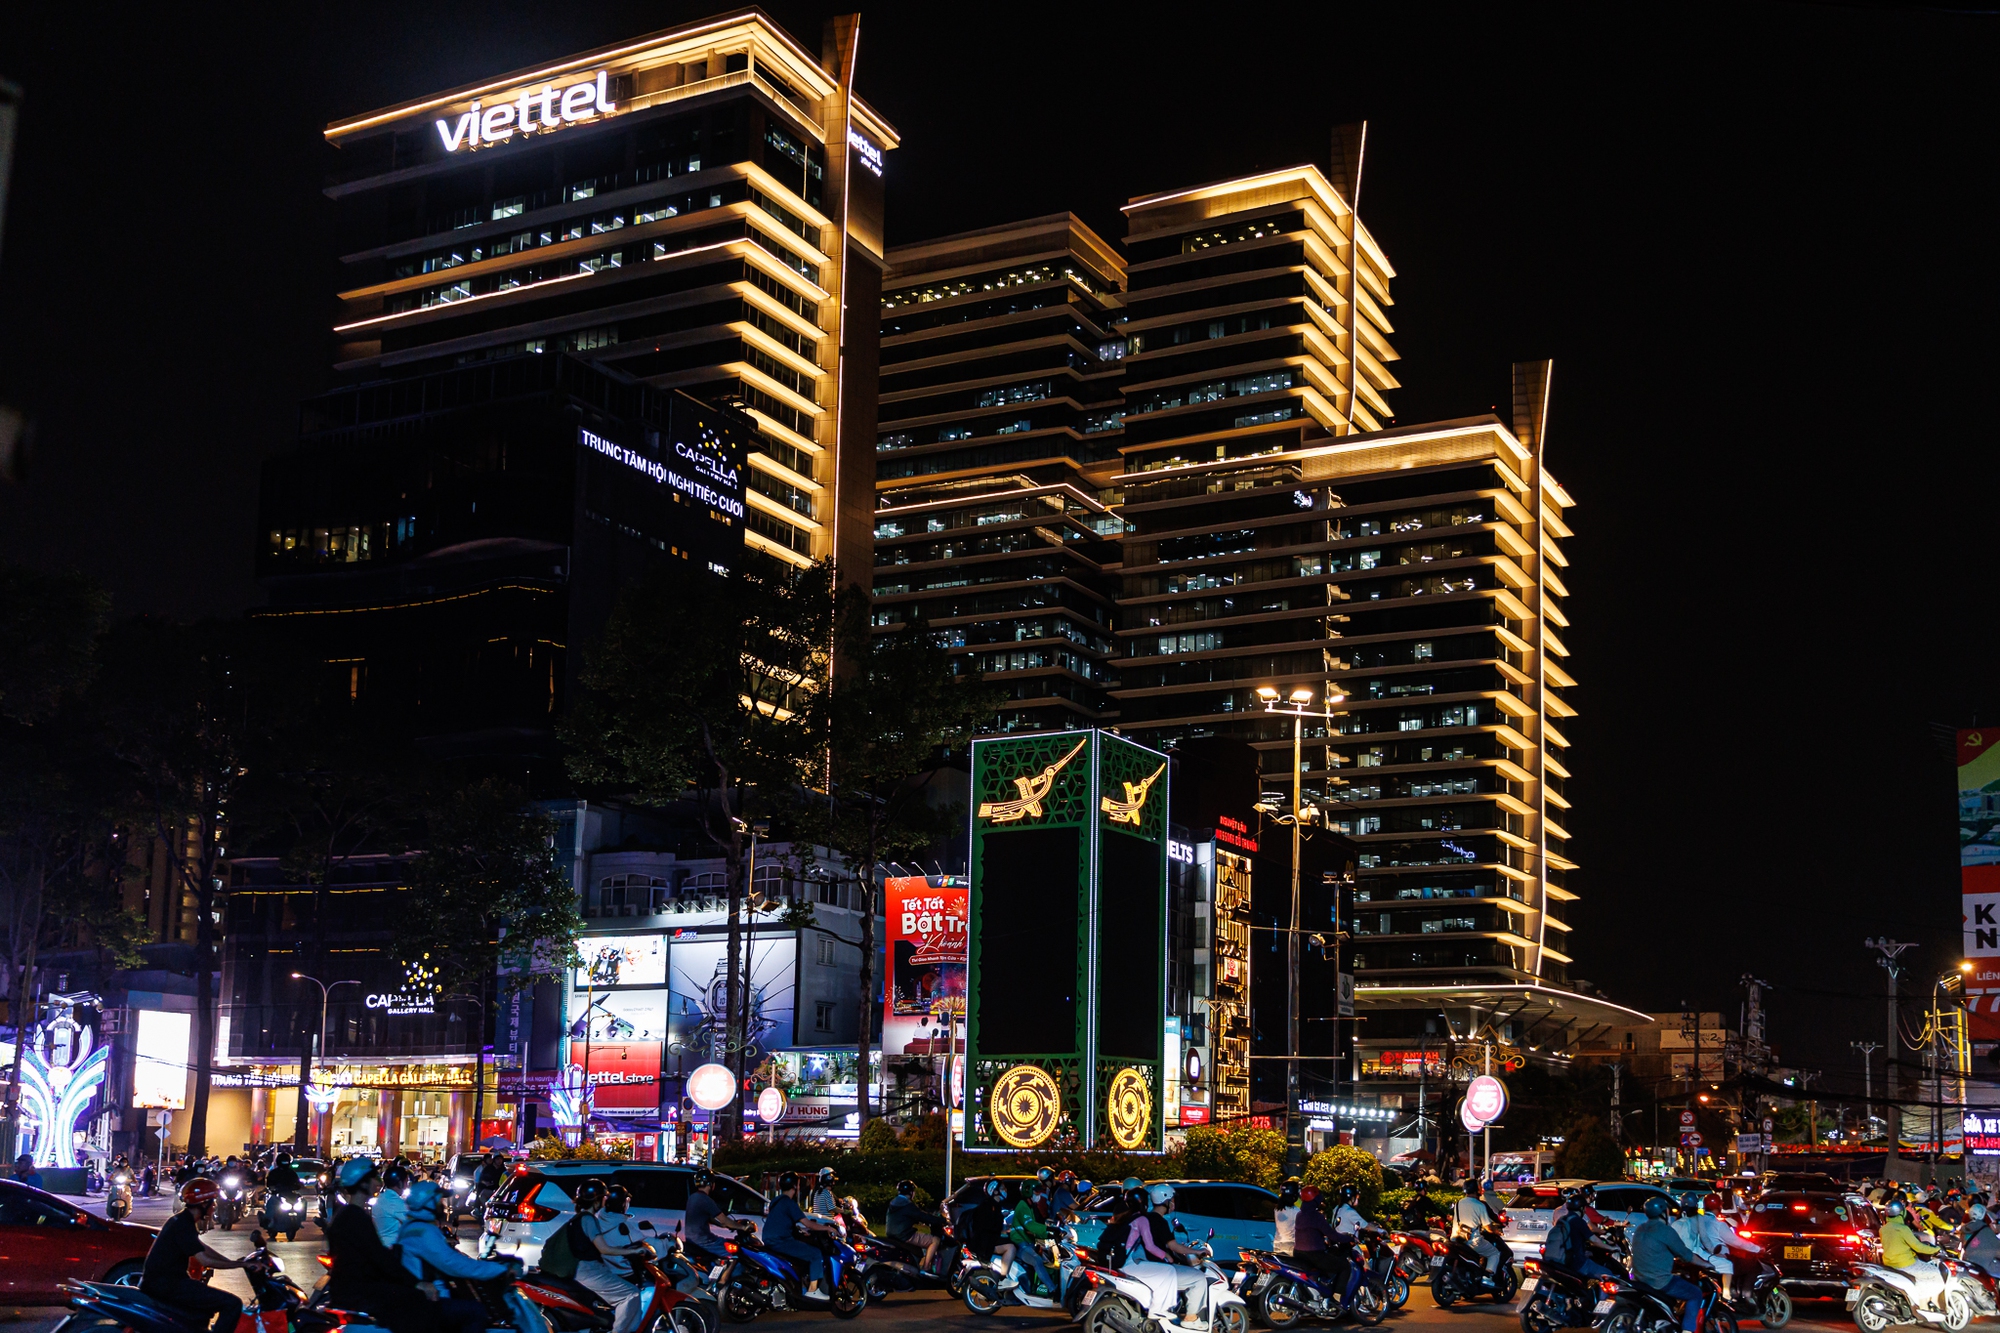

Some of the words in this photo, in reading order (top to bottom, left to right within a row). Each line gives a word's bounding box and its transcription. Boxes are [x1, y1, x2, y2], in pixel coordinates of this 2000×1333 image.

[436, 71, 615, 151] viettel
[582, 430, 622, 461] TRUNG
[623, 449, 646, 472] TÂM
[648, 462, 667, 483] HỘI
[668, 471, 694, 497] NGHỊ
[695, 484, 717, 504] TIỆC
[676, 443, 738, 483] CAPELLA
[901, 896, 922, 911] Tết
[923, 896, 945, 910] Tất
[901, 911, 943, 940] Bật
[945, 915, 969, 933] Tr
[211, 1074, 243, 1086] TRUNG
[354, 1074, 399, 1085] CAPELLA
[798, 1105, 828, 1115] HÙNG
[1252, 1116, 1271, 1128] 275
[1984, 1118, 1997, 1133] XE
[341, 1145, 382, 1154] CAPELLA
